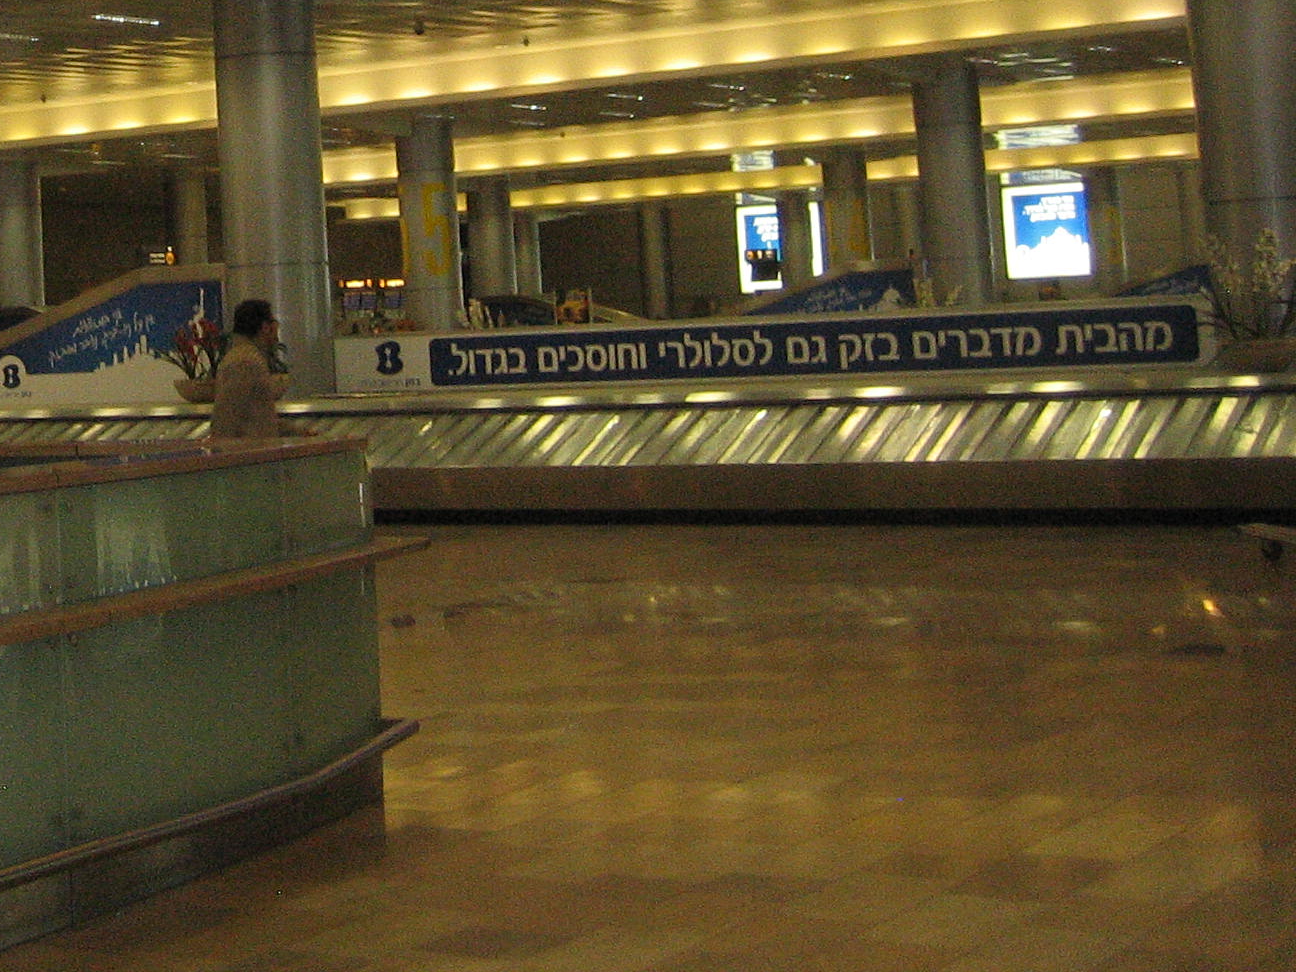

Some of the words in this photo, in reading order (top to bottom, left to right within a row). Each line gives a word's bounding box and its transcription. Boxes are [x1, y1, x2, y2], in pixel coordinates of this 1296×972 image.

[422, 182, 452, 276] 5
[658, 329, 773, 369] לסלולרי
[785, 334, 827, 365] גם
[838, 332, 900, 370] בזק
[911, 326, 1041, 360] מדברים
[1056, 320, 1172, 356] מהבית
[448, 342, 528, 376] בגדול.
[536, 341, 648, 374] וחוסכים
